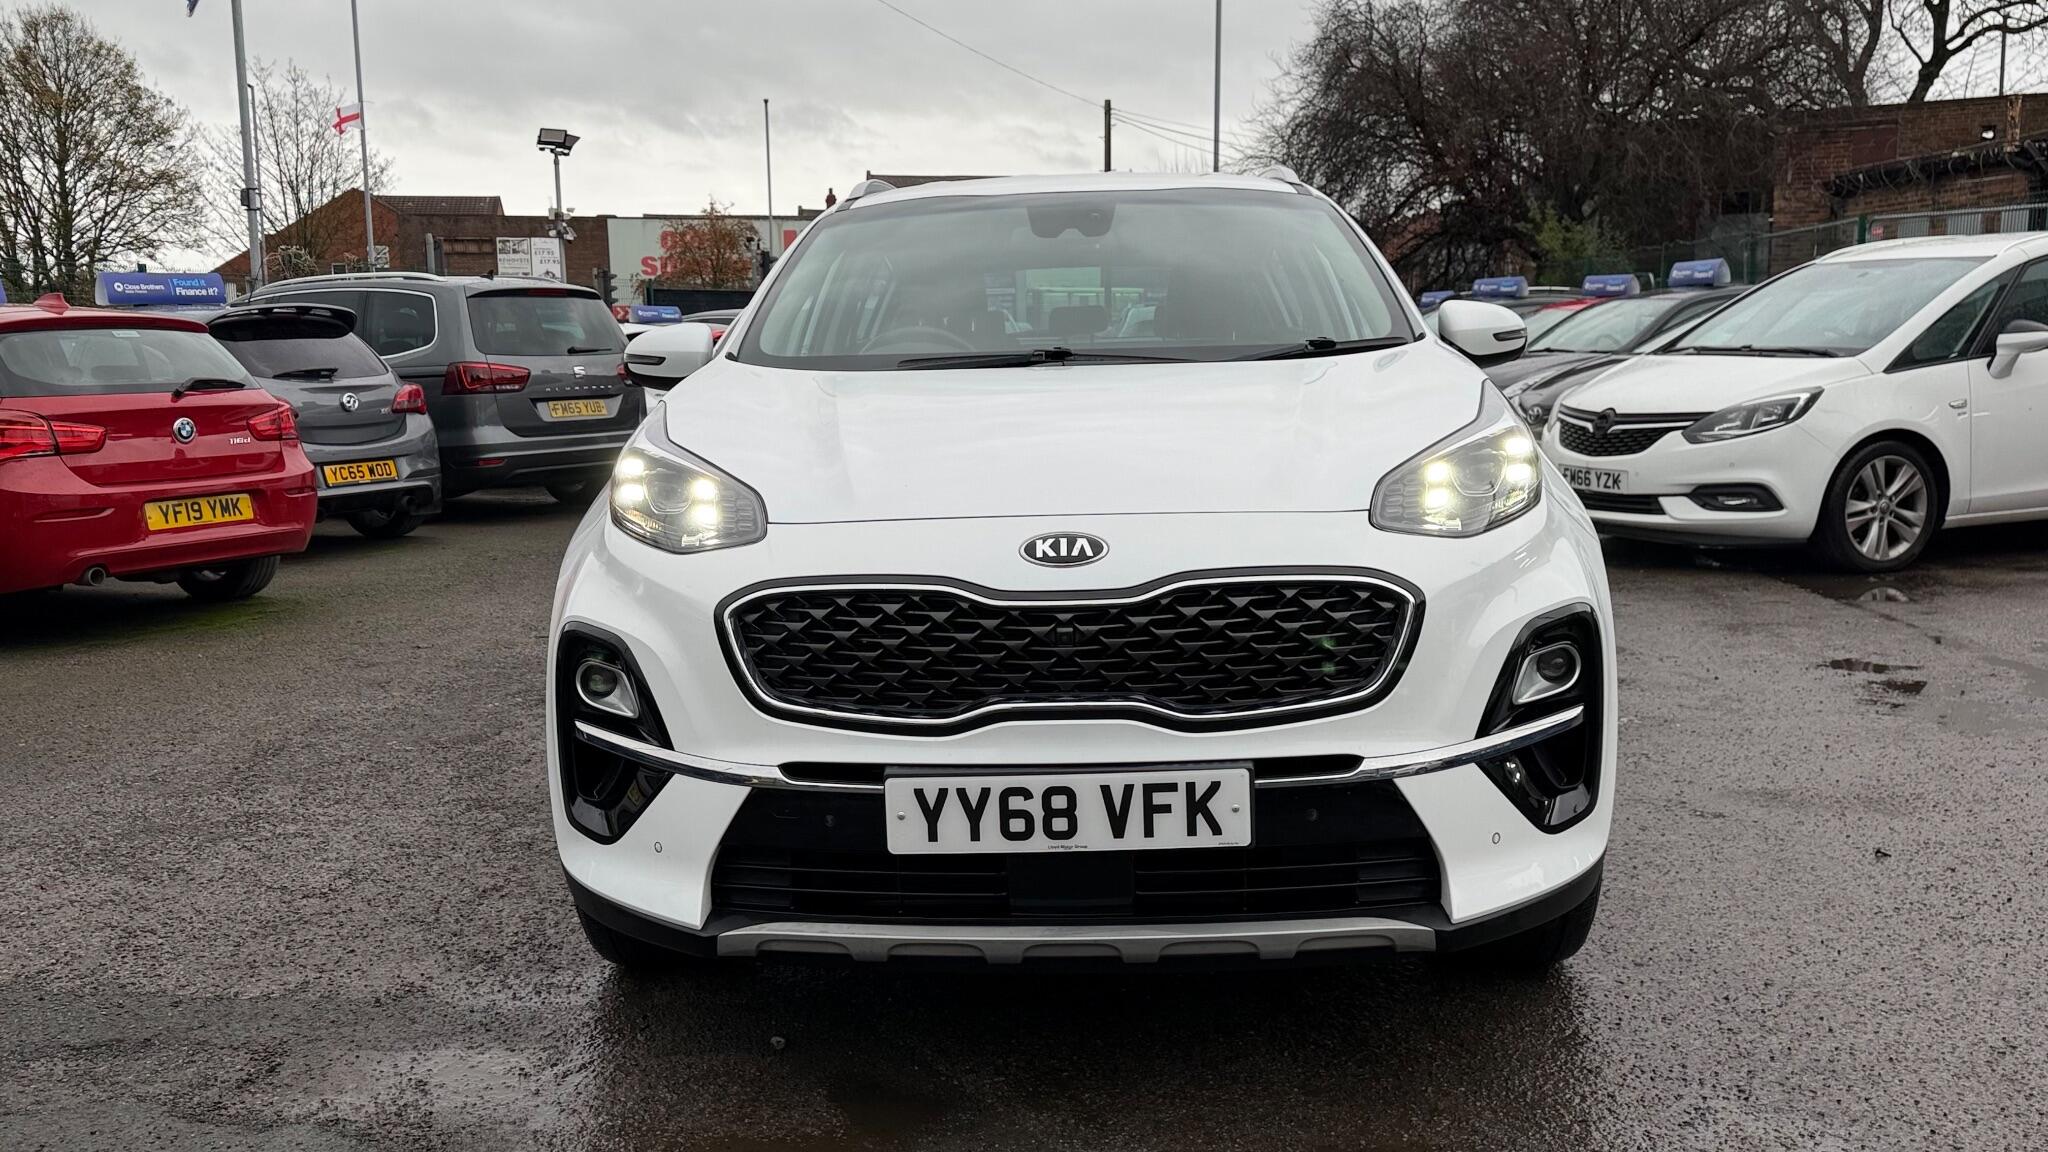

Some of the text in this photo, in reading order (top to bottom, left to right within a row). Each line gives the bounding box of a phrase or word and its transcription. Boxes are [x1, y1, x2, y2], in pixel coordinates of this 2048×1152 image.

[172, 278, 199, 286] Found
[176, 287, 218, 296] Finance it?
[330, 462, 392, 482] YC65 WOD
[1563, 468, 1621, 490] FM66 YZK
[158, 497, 243, 524] YF19 YMK
[1035, 538, 1094, 558] KIA
[913, 780, 1223, 842] YY68 VFK
